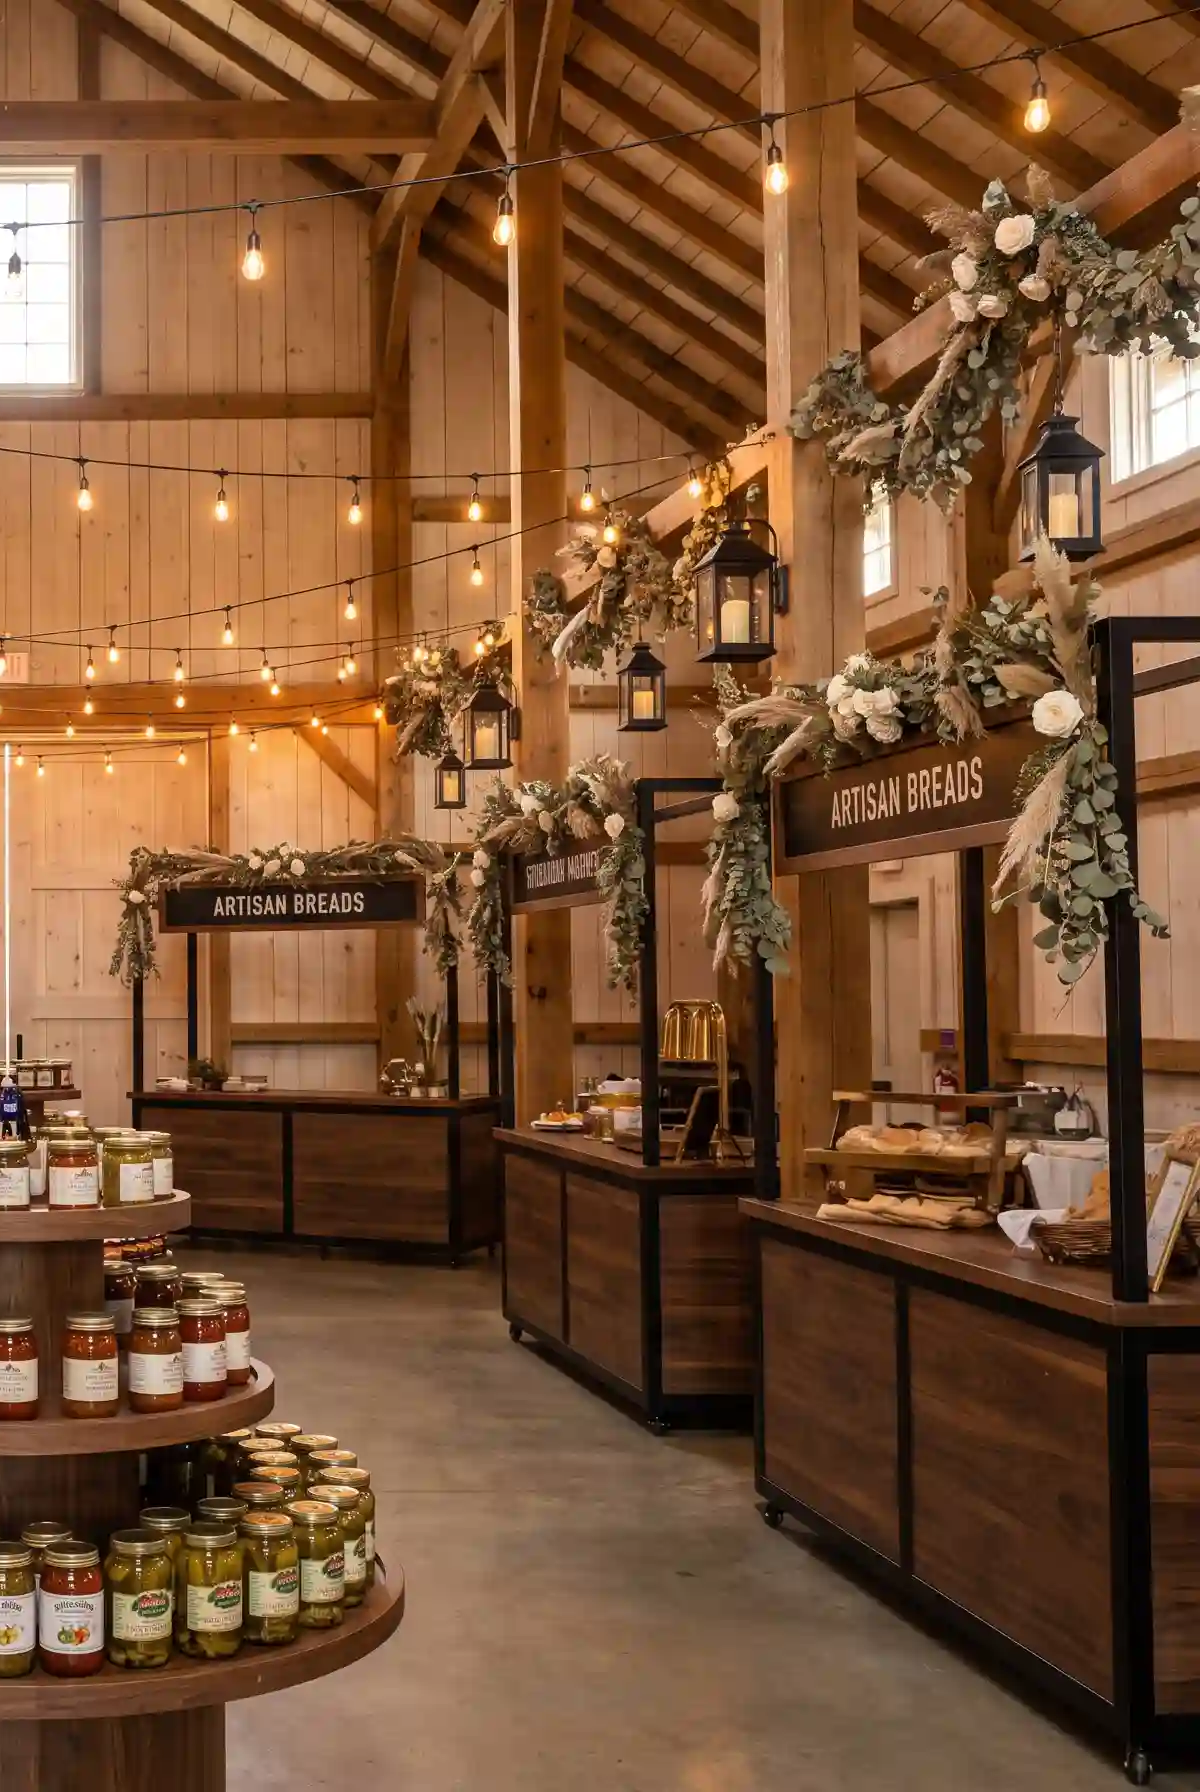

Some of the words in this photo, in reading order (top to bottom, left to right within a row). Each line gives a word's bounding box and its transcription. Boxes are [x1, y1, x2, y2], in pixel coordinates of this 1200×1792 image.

[831, 775, 901, 829] ARTISAN
[907, 755, 983, 813] BREADS
[213, 894, 287, 917] ARTISAN
[294, 891, 365, 915] BREADS
